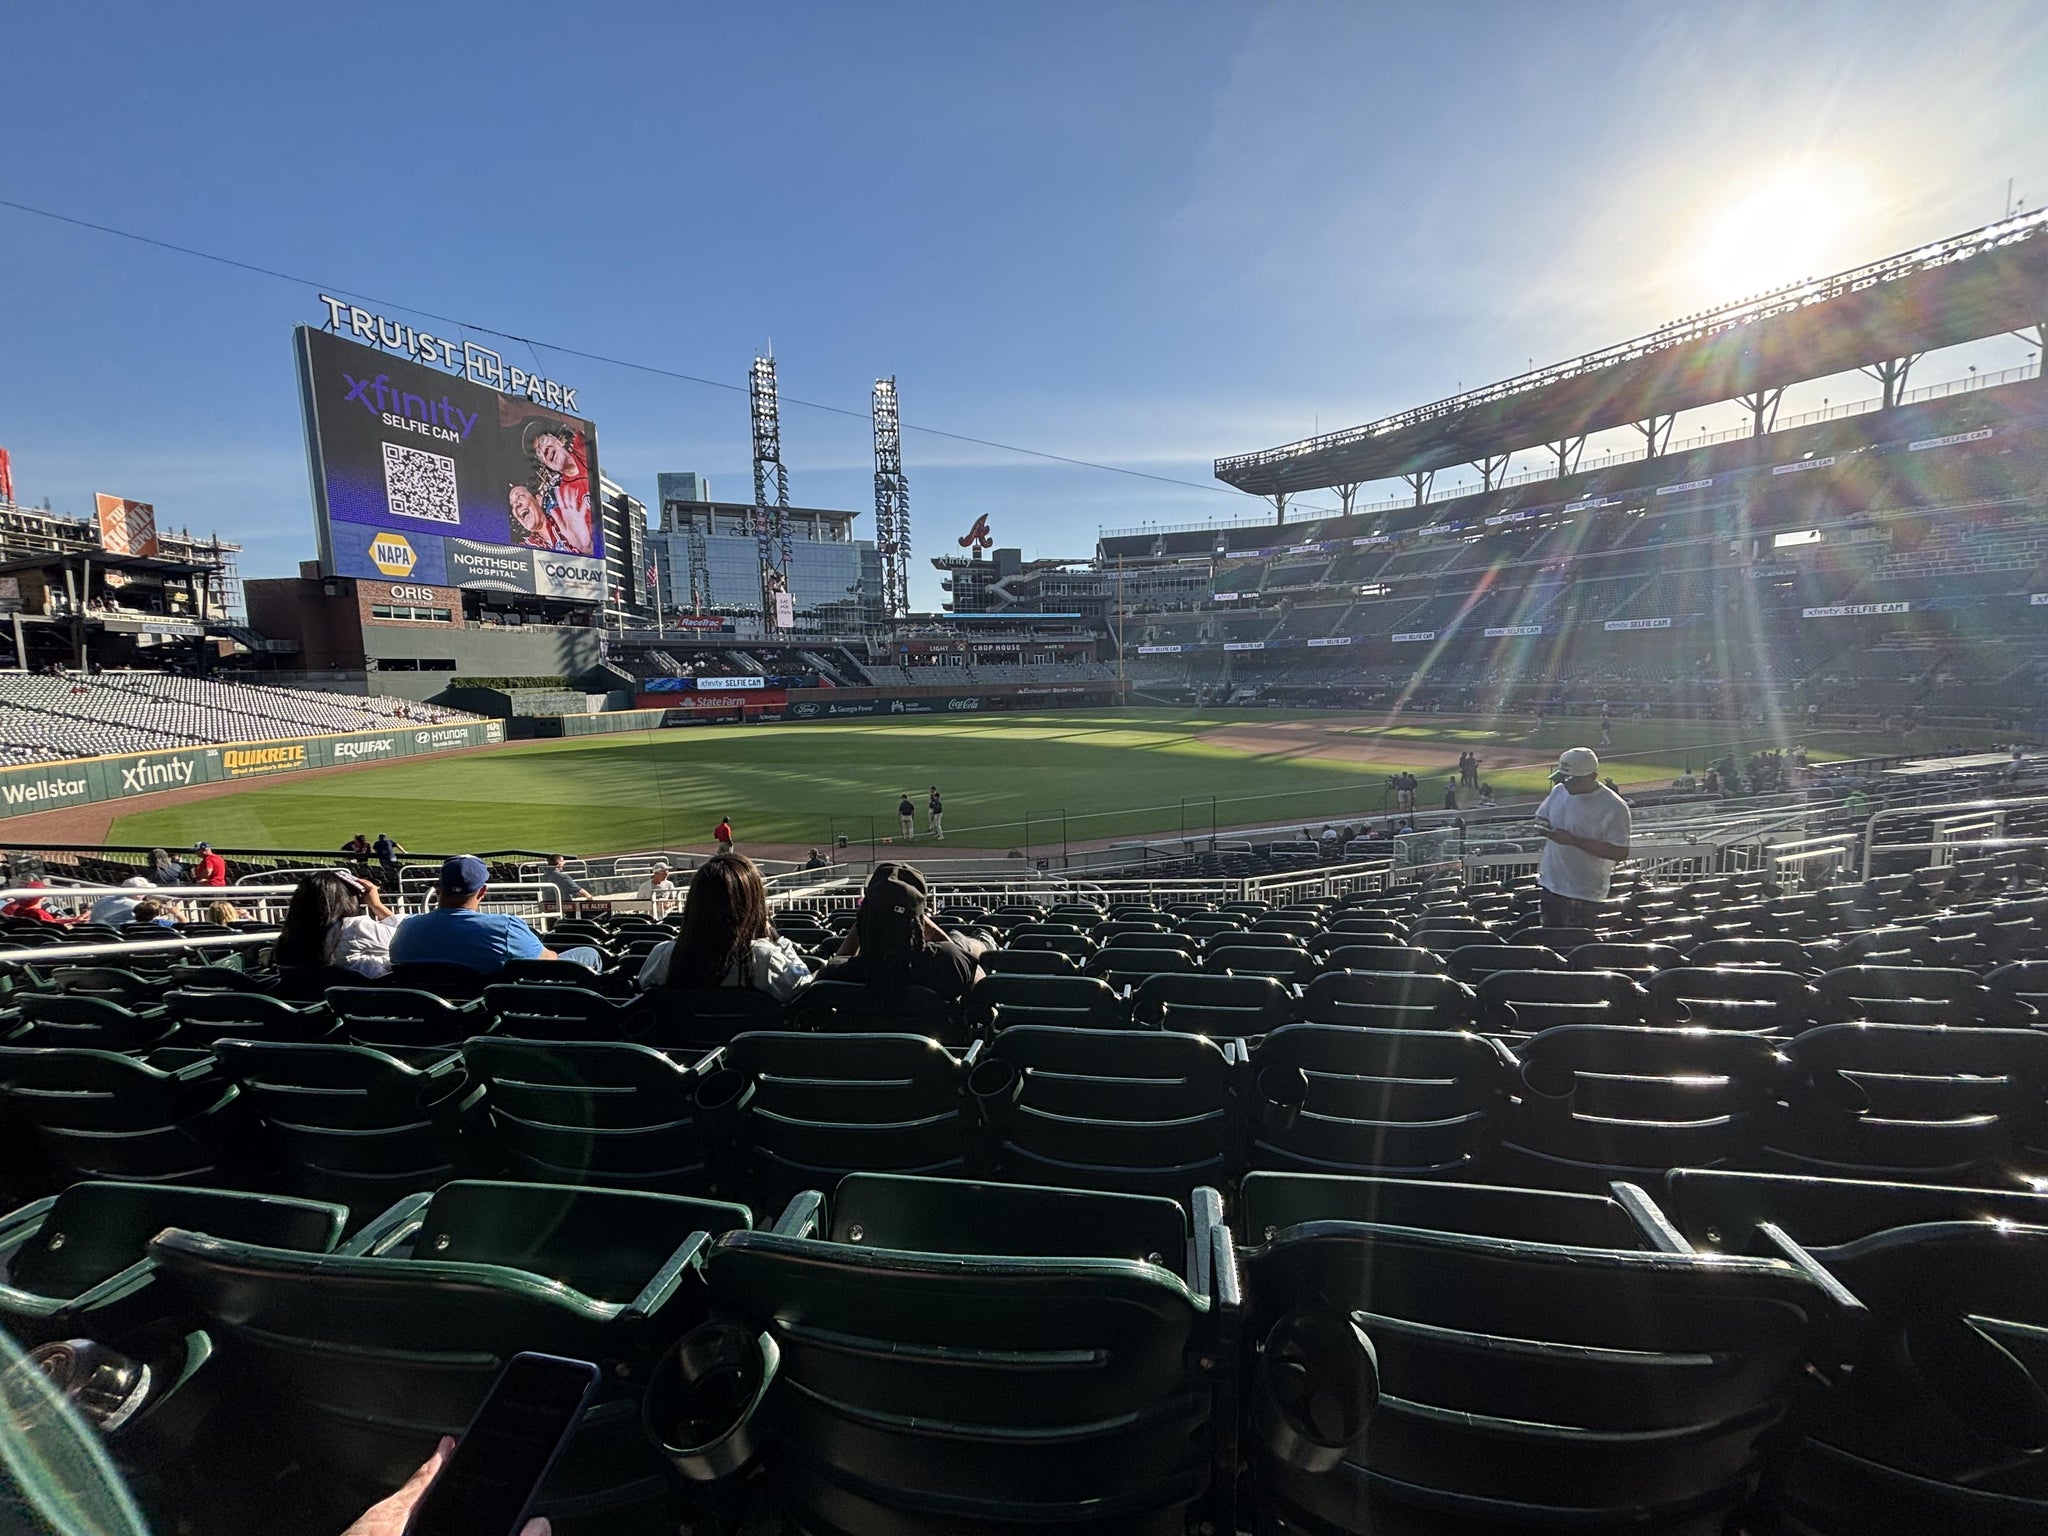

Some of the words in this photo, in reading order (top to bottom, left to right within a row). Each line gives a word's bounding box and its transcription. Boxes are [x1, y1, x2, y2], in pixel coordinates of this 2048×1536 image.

[319, 293, 457, 368] TRUIST
[509, 366, 579, 413] PARK
[343, 374, 479, 439] xfinity
[382, 412, 431, 436] SELFIE
[432, 426, 460, 443] CAM
[106, 504, 126, 526] THE
[104, 503, 153, 551] HOME
[129, 524, 156, 555] DEPOT
[377, 544, 410, 566] NAPA
[454, 553, 529, 572] NORTHSIDE
[469, 566, 516, 578] HOSPITAL
[545, 564, 603, 582] COOLRAY
[391, 585, 433, 601] ORIS
[1808, 608, 1840, 616] xfinity
[1843, 605, 1878, 614] SELFIE
[1880, 603, 1904, 612] CAM
[681, 619, 720, 627] RaceTrac
[700, 680, 722, 688] xfinity
[726, 679, 746, 687] SELFIE
[748, 678, 761, 686] CAM
[838, 706, 857, 714] Georgia
[431, 729, 469, 742] HYUNDAI
[223, 745, 305, 768] QUIKRETE
[334, 738, 393, 758] EQUIFAX
[121, 756, 194, 791] xfinity
[1, 778, 87, 804] Wellstar
